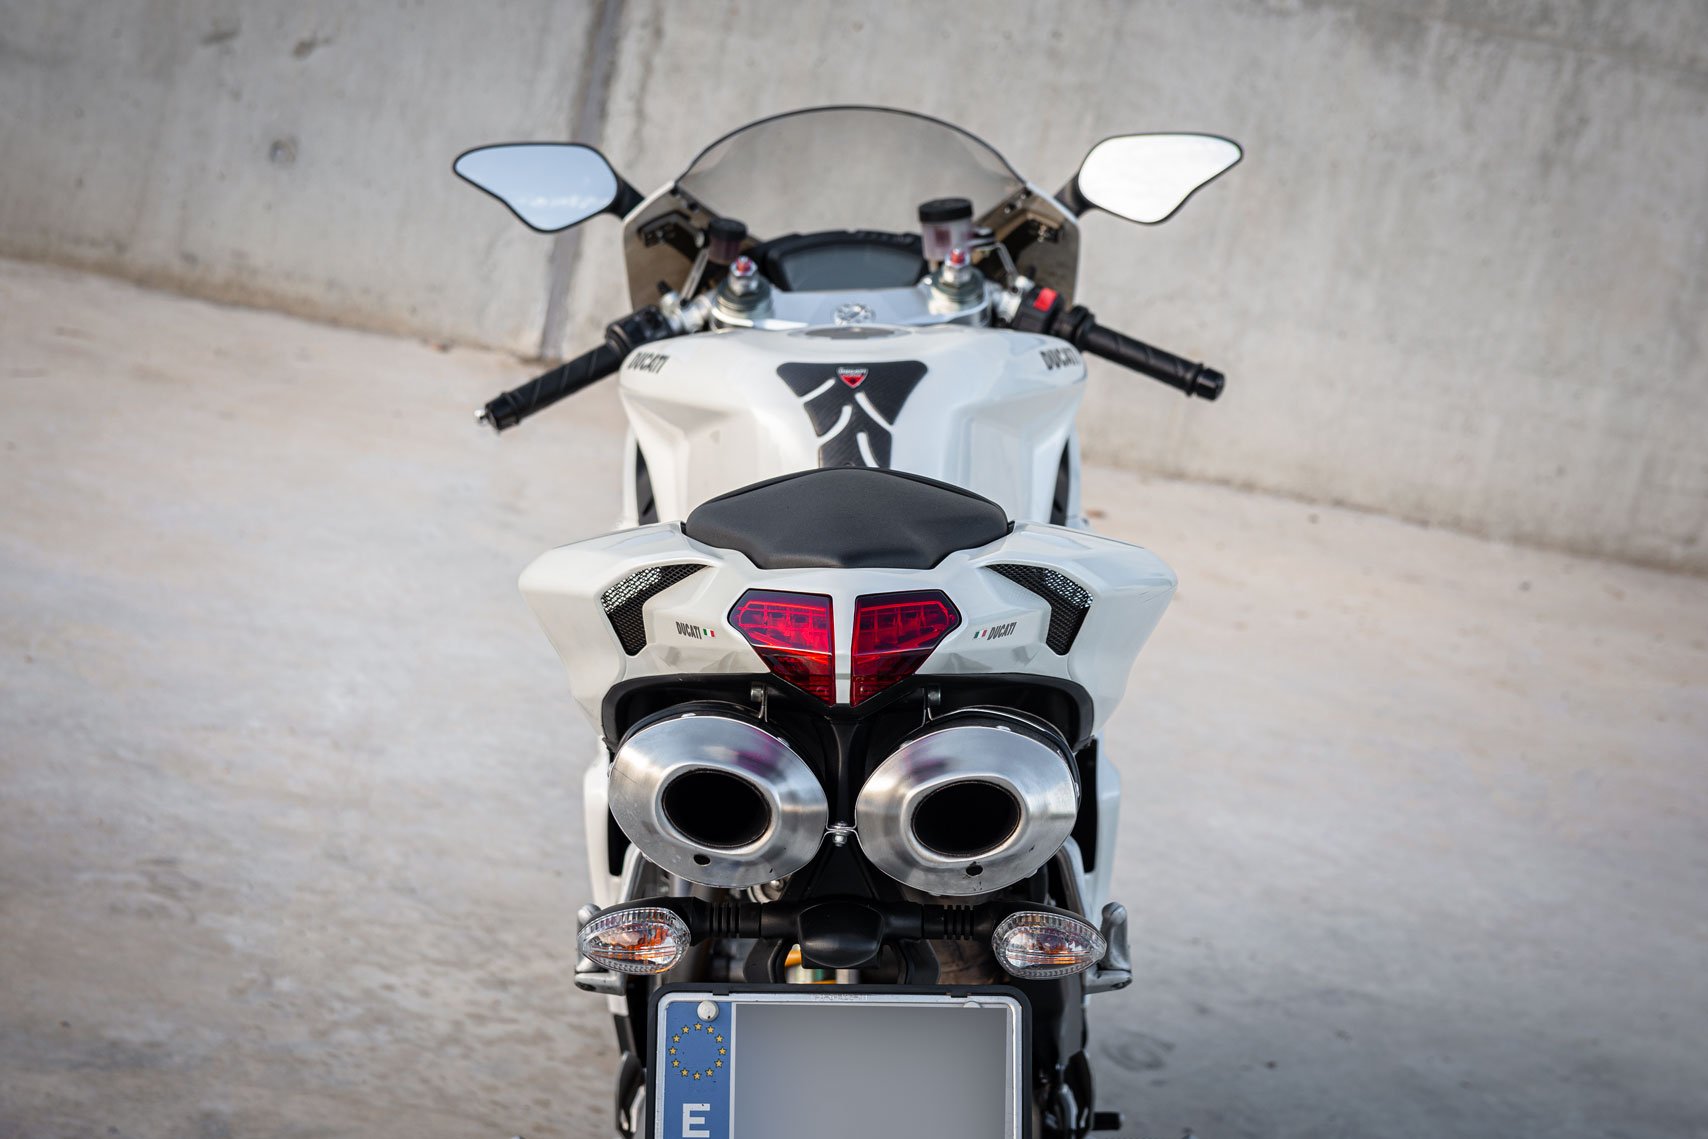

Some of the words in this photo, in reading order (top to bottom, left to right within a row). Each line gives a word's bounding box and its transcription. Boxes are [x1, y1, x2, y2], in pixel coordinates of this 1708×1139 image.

[628, 351, 670, 373] DUCATI
[1040, 348, 1079, 370] DUCATI
[675, 621, 702, 640] DUCATI
[987, 621, 1017, 640] DUCATI
[682, 1103, 710, 1138] E
